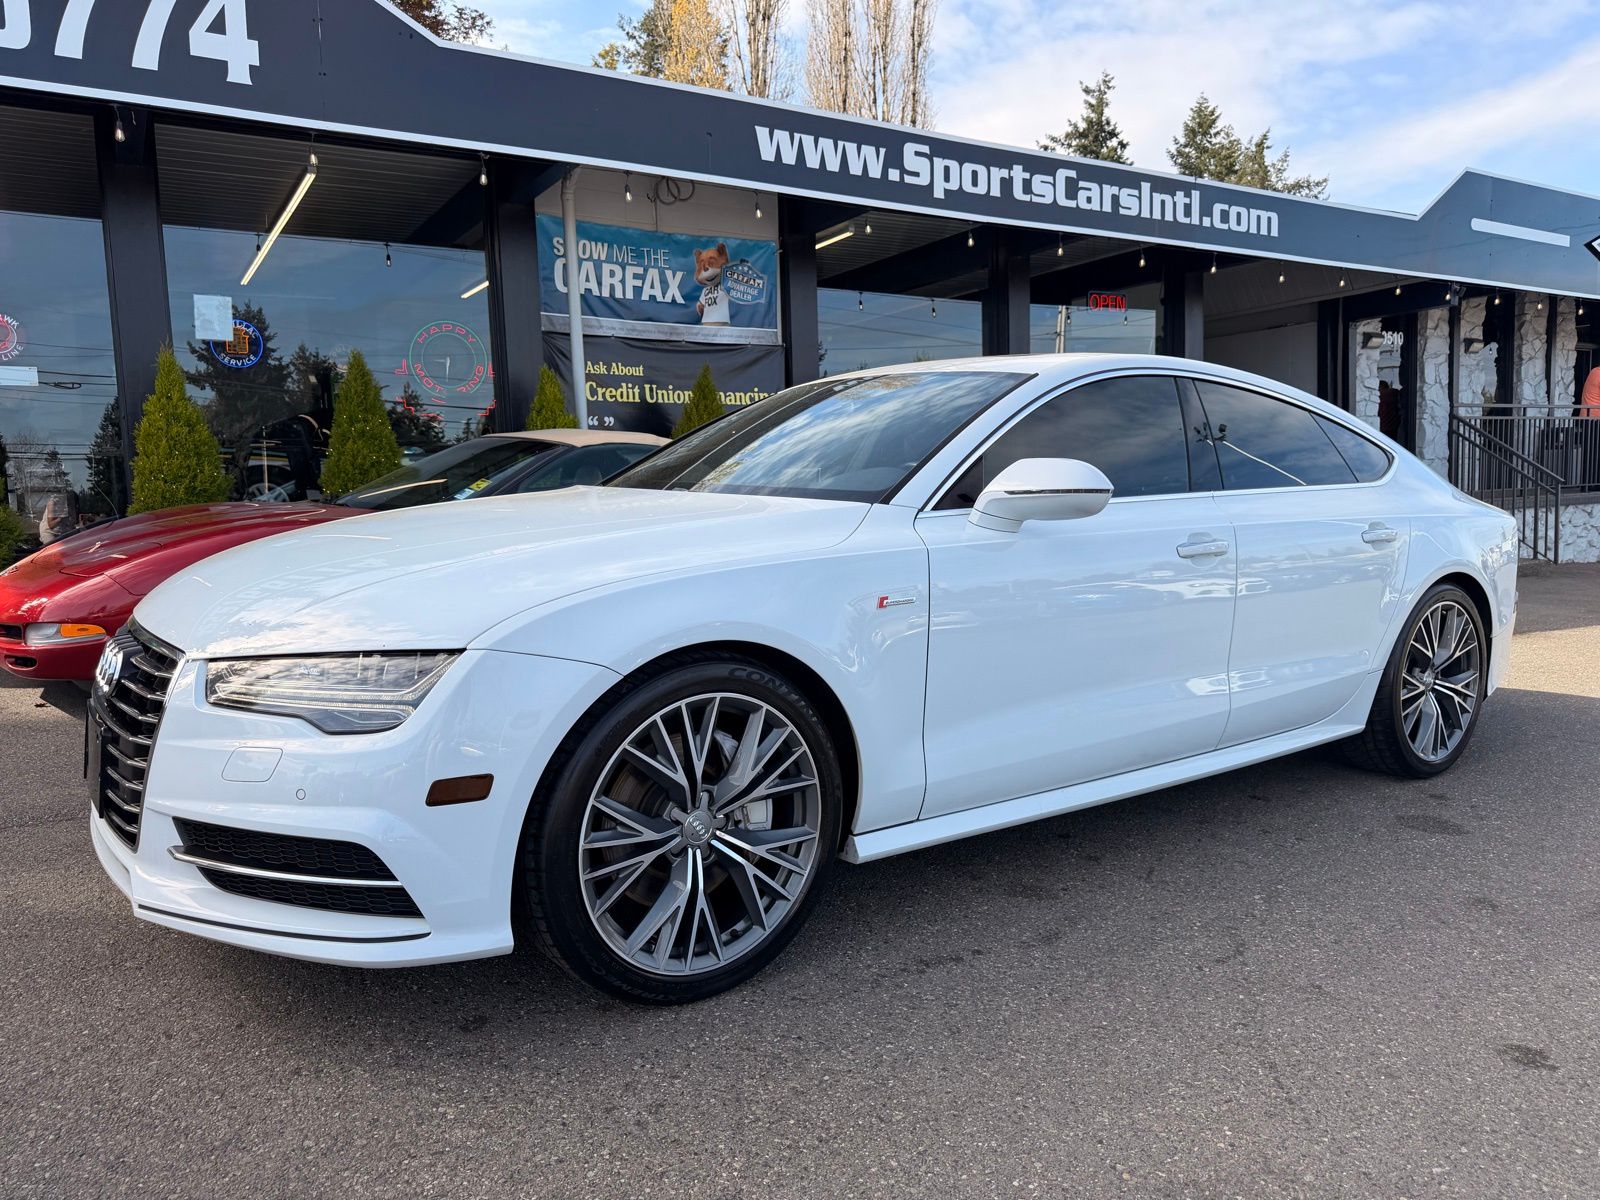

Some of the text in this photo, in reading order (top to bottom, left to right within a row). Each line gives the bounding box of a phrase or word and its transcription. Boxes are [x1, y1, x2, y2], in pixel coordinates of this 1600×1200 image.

[754, 125, 1279, 237] www.SportsCarsIntl.com
[553, 237, 670, 268] SOW ME THE
[554, 257, 686, 304] CARFAX
[726, 270, 763, 288] CARFAX
[727, 281, 759, 296] ADVANTAGE
[729, 290, 752, 301] DEALER
[1090, 294, 1126, 312] OPEN
[417, 323, 477, 344] HAPPY
[219, 353, 257, 367] SERVICE
[585, 361, 644, 377] Ask About
[414, 363, 484, 393] MOTRING
[585, 381, 641, 403] Credit
[644, 384, 693, 405] Union
